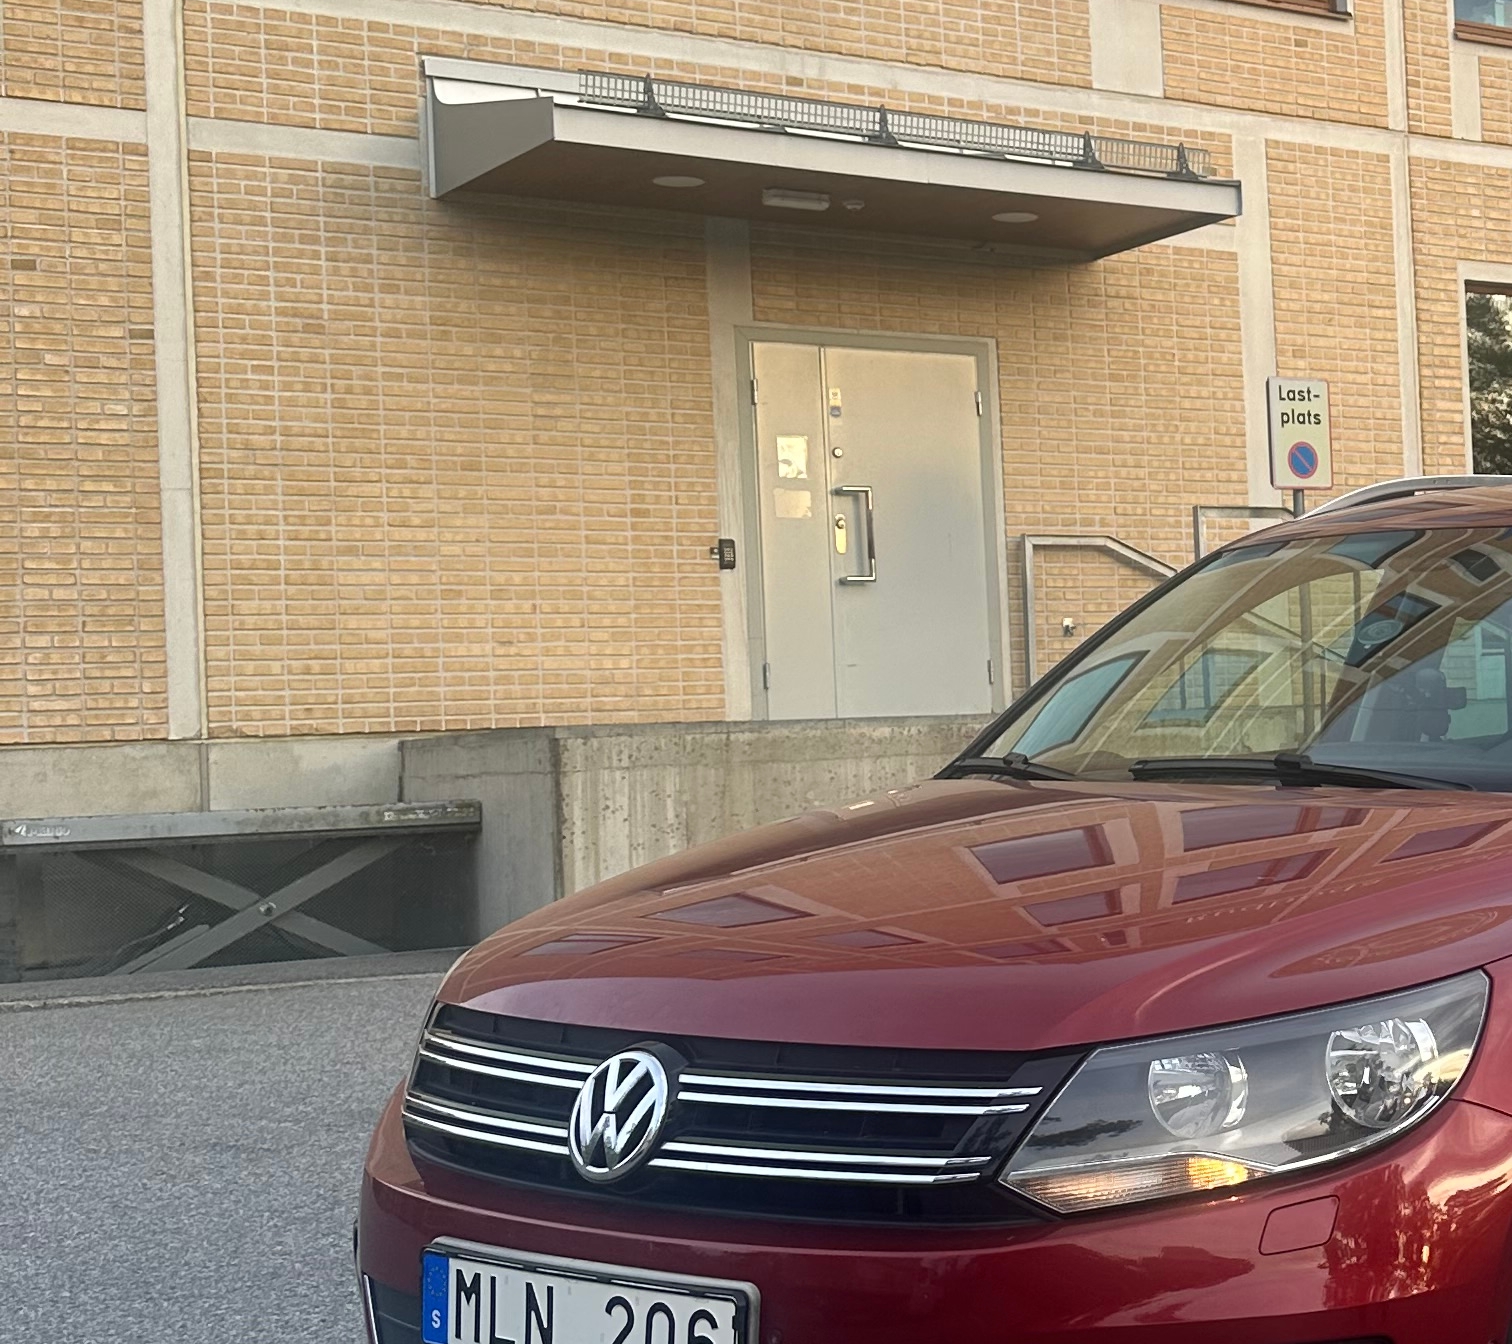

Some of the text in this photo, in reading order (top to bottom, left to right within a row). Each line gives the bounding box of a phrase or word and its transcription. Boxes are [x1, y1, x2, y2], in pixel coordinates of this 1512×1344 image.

[1278, 385, 1321, 402] Last-
[1280, 408, 1322, 428] plats
[431, 1309, 441, 1330] S
